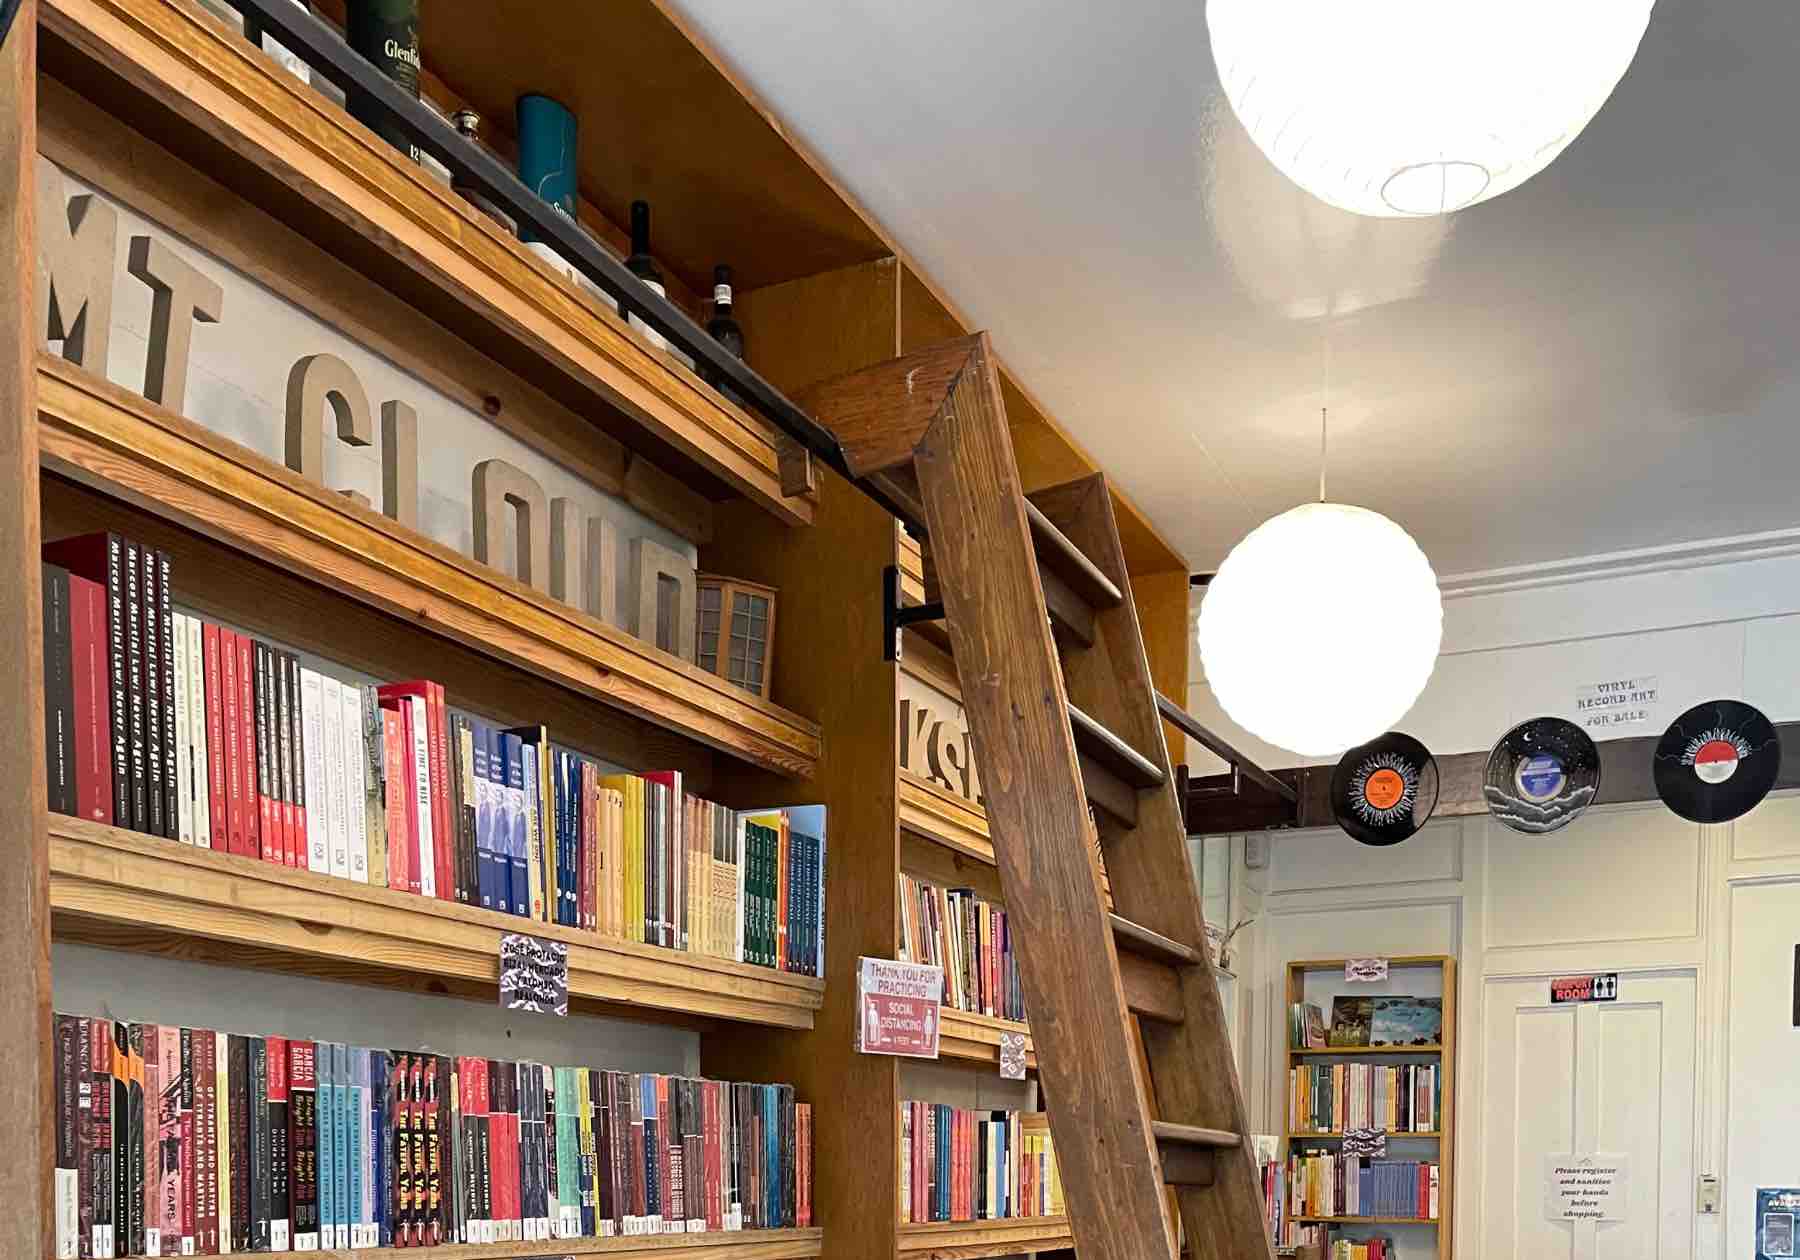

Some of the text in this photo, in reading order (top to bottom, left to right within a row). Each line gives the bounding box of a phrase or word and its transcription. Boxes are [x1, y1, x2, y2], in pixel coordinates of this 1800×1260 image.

[39, 158, 223, 416] MT
[110, 541, 127, 775] Marcos Martial Law: Never Again
[128, 548, 144, 778] Marcos Martial Law: Never Again
[145, 553, 161, 782] Marcos Martial Law: Never Again
[162, 561, 177, 788] Marcos Martial Law: Never Again
[1578, 690, 1656, 709] RECORD ART
[1586, 710, 1646, 726] FOR SALE
[871, 963, 937, 984] THANK YOU FOR
[879, 979, 928, 998] PRACTICING
[1556, 988, 1590, 1000] ROOM
[888, 1001, 914, 1016] SOCIAL
[880, 1016, 922, 1032] DISTANCING
[207, 1087, 213, 1098] OF
[167, 1179, 175, 1220] YEARS
